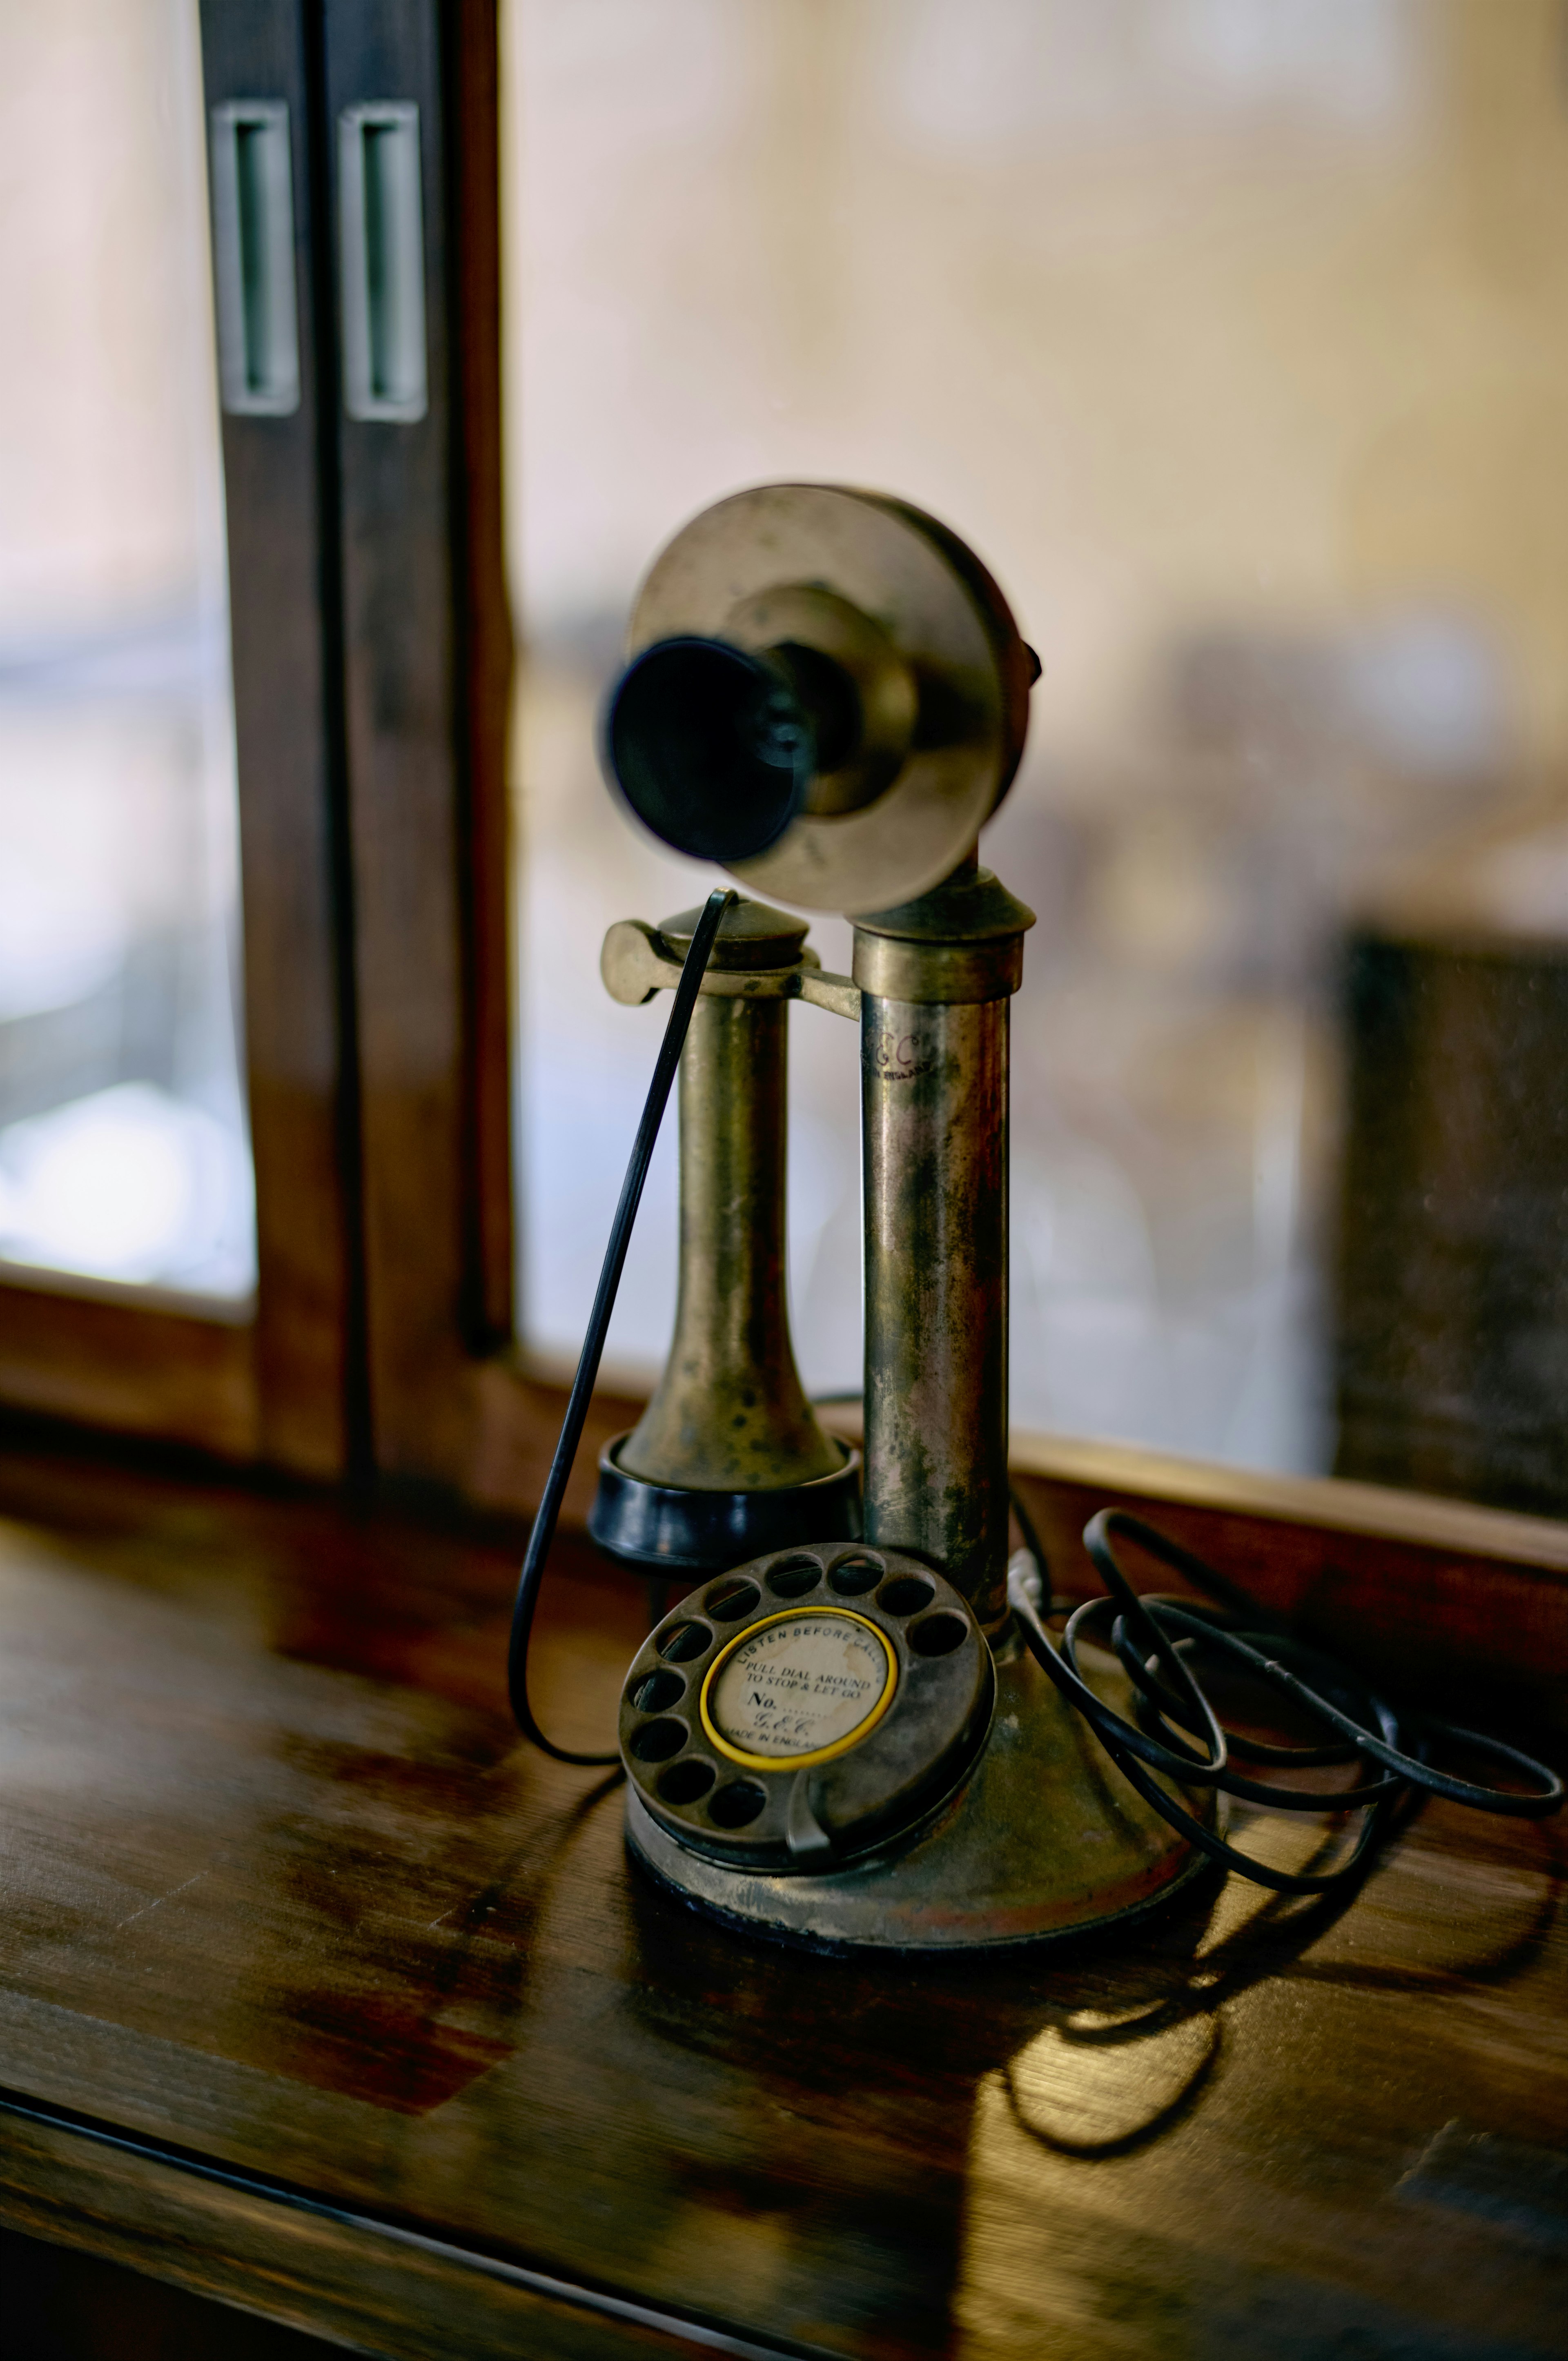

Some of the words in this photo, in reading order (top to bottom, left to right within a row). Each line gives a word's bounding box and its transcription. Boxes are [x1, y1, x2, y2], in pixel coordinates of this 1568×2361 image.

[737, 1630, 786, 1665] LISTEN
[793, 1626, 852, 1641] BEFORE
[746, 1661, 776, 1675] PULL
[781, 1667, 811, 1680] DIAL
[815, 1675, 871, 1690] AROUND
[747, 1673, 763, 1683] TO
[766, 1674, 798, 1688] STOP
[800, 1683, 809, 1691] &
[813, 1684, 840, 1695] LET
[842, 1689, 861, 1699] GO
[758, 1733, 771, 1742] IN
